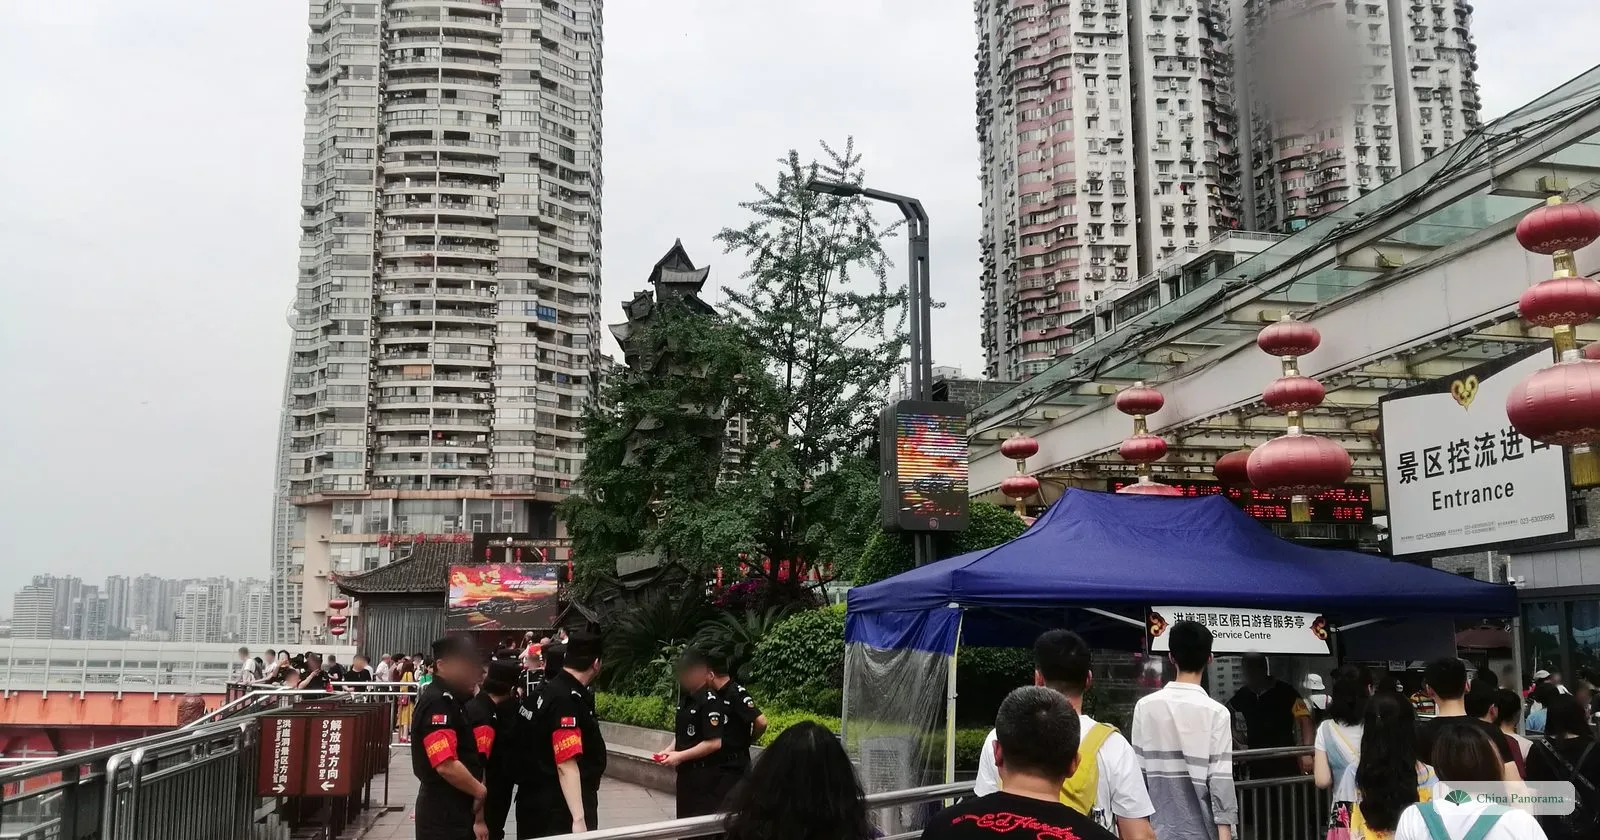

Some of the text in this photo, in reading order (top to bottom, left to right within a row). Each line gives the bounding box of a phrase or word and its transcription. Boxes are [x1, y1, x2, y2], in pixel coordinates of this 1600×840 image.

[1432, 482, 1514, 510] Entrance
[1212, 630, 1271, 640] Service Centre
[322, 720, 329, 729] Go
[322, 729, 329, 738] To
[279, 719, 291, 784] 洪崖洞景区方向
[327, 719, 342, 780] 解放碑方向
[318, 750, 327, 768] Fang
